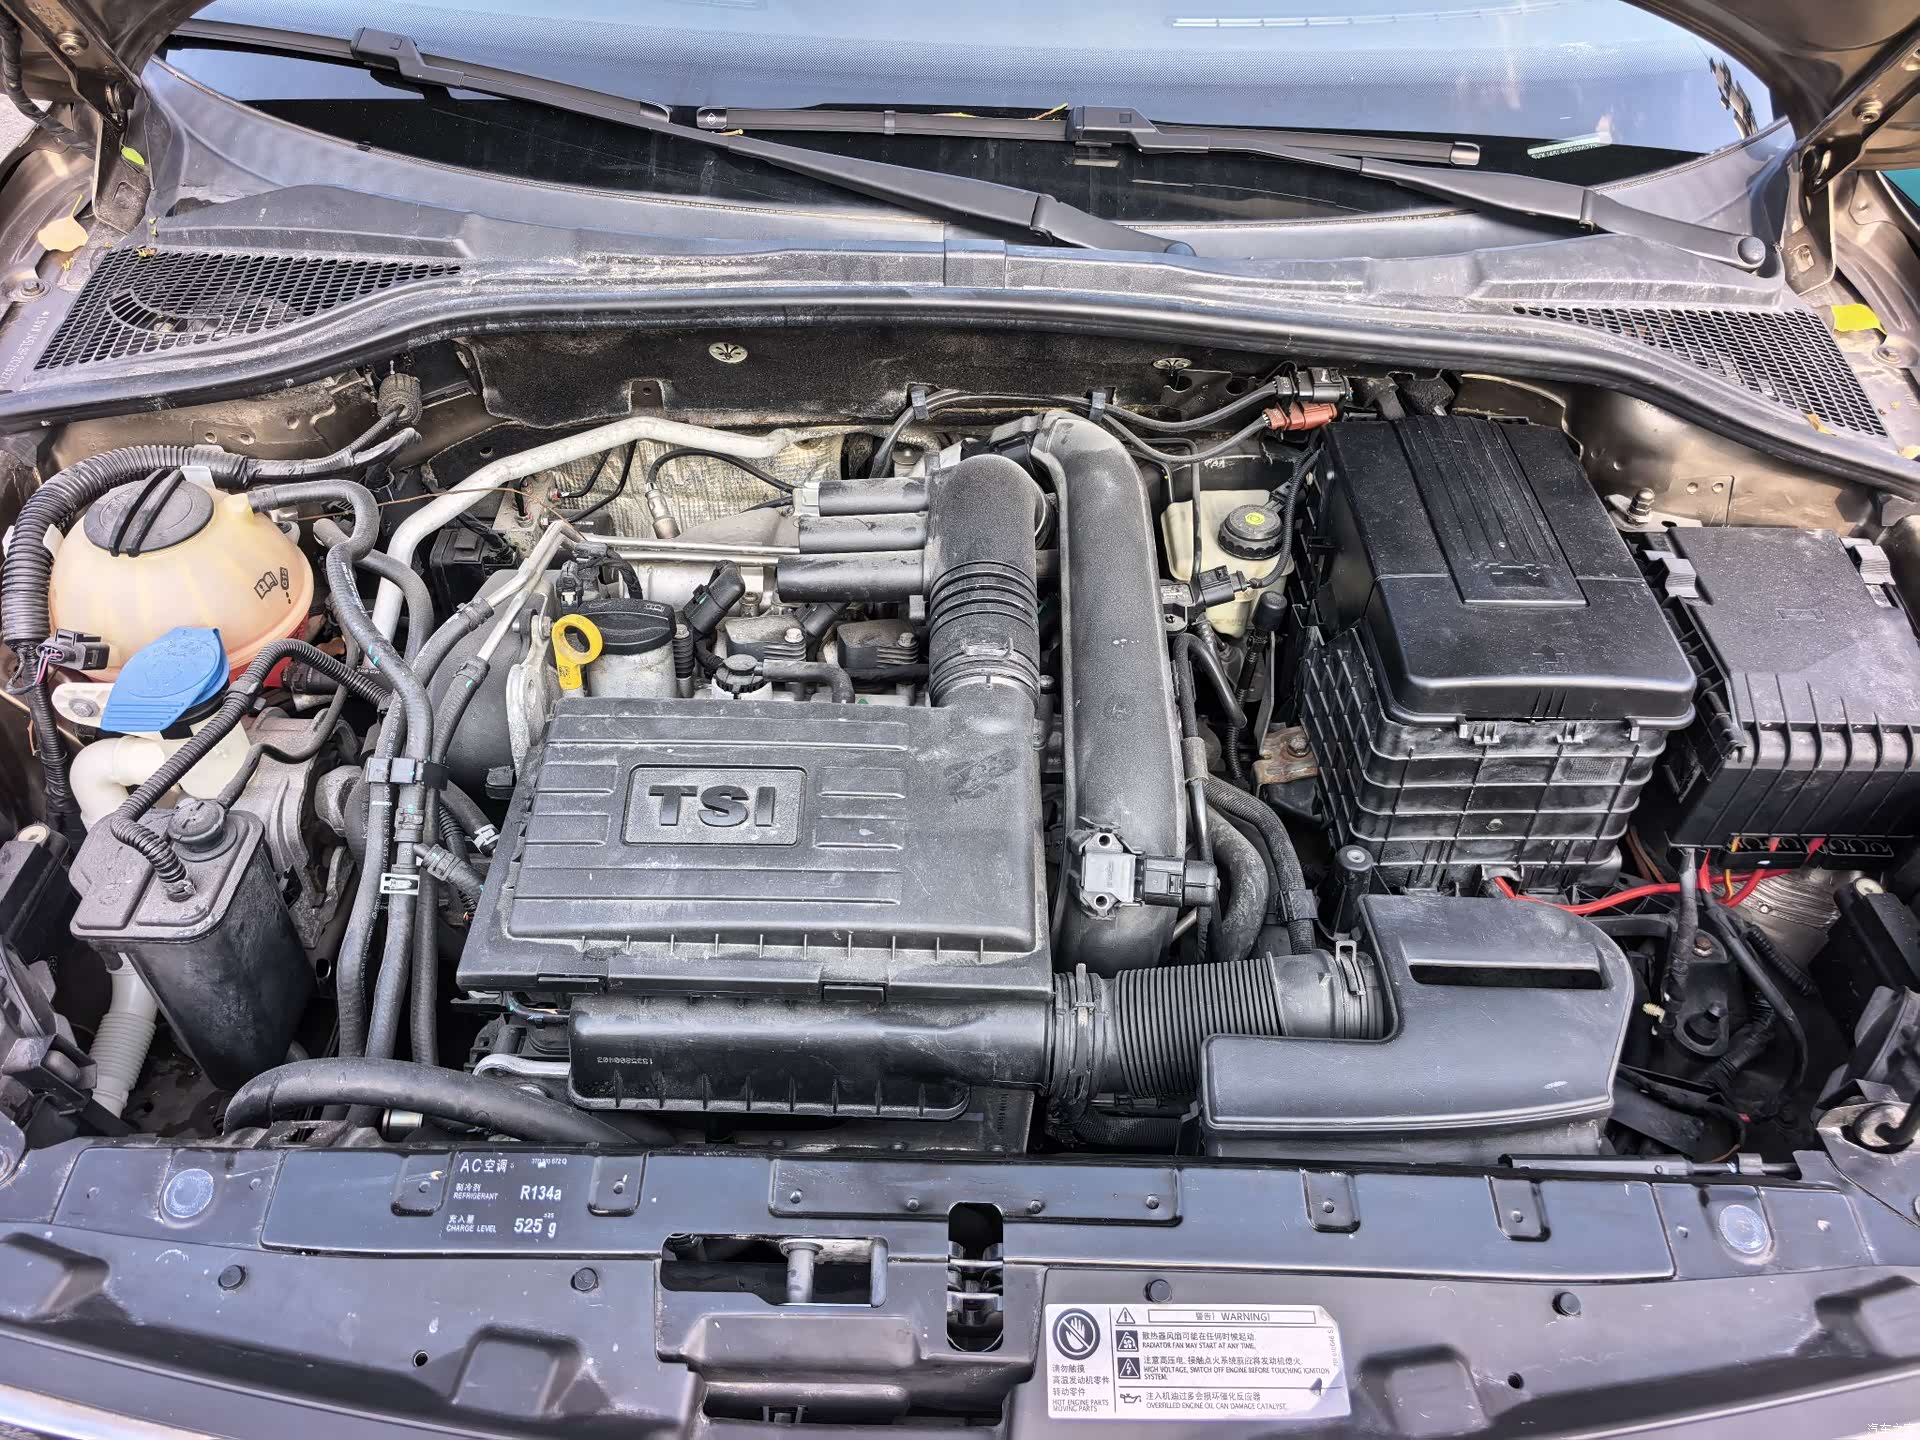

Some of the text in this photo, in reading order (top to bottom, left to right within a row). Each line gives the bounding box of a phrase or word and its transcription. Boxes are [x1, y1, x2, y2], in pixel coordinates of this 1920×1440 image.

[648, 785, 775, 827] TSI
[453, 1192, 499, 1200] REFRIGERANT
[520, 1185, 562, 1200] R134a
[446, 1224, 497, 1233] CHARGE LEVEL
[513, 1217, 557, 1238] 525 g
[1220, 1312, 1270, 1322] WARNING!
[1142, 1341, 1172, 1349] RADIATOR
[1190, 1366, 1212, 1374] SWITCH
[1271, 1367, 1302, 1375] TOUCHING
[1303, 1367, 1330, 1375] IGNITION
[1215, 1402, 1228, 1410] CAN
